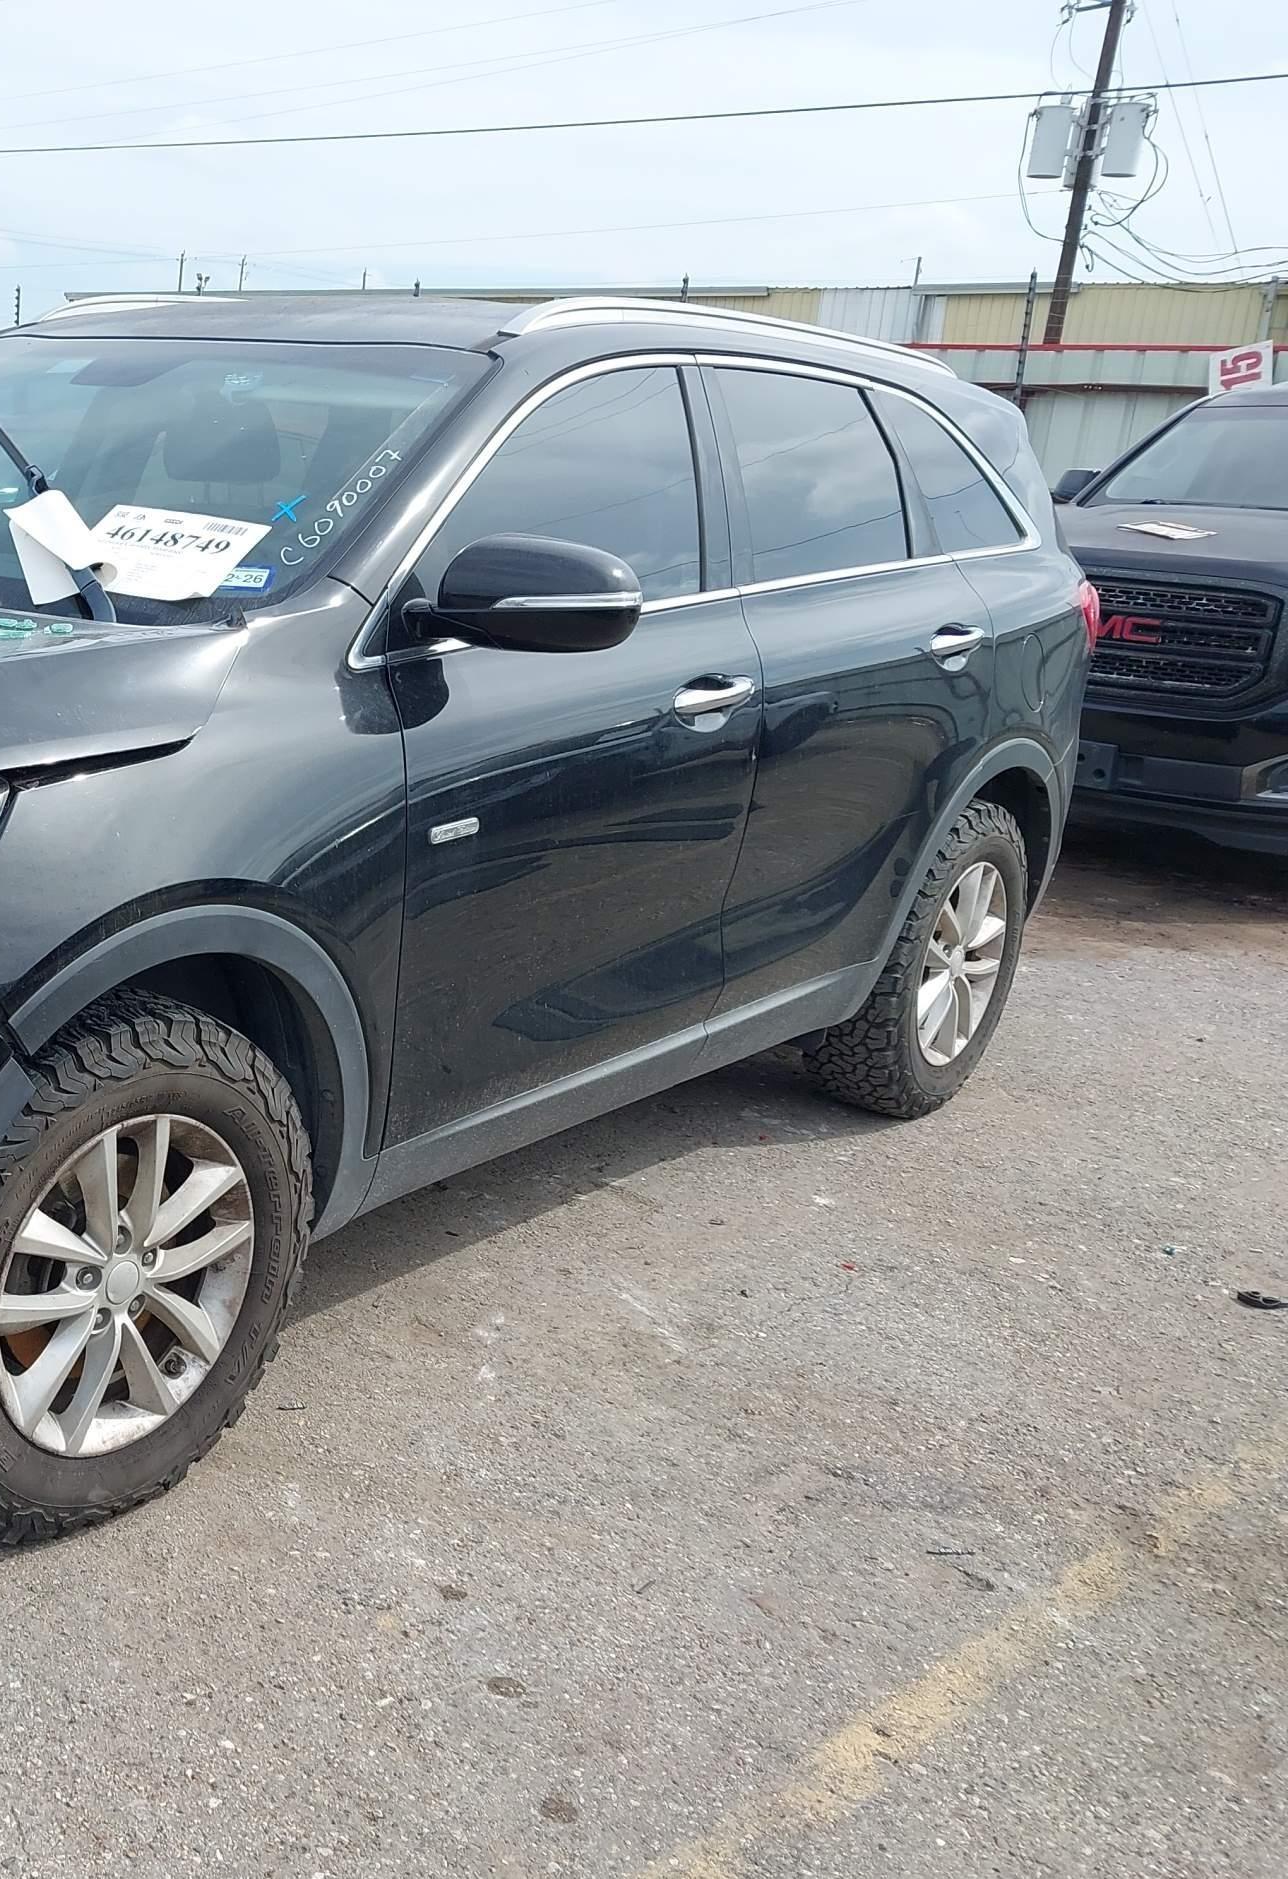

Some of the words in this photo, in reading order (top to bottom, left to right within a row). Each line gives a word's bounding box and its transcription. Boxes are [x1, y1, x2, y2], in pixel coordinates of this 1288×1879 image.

[1220, 350, 1263, 391] 15
[106, 524, 231, 555] 46148749
[1097, 614, 1162, 644] MC
